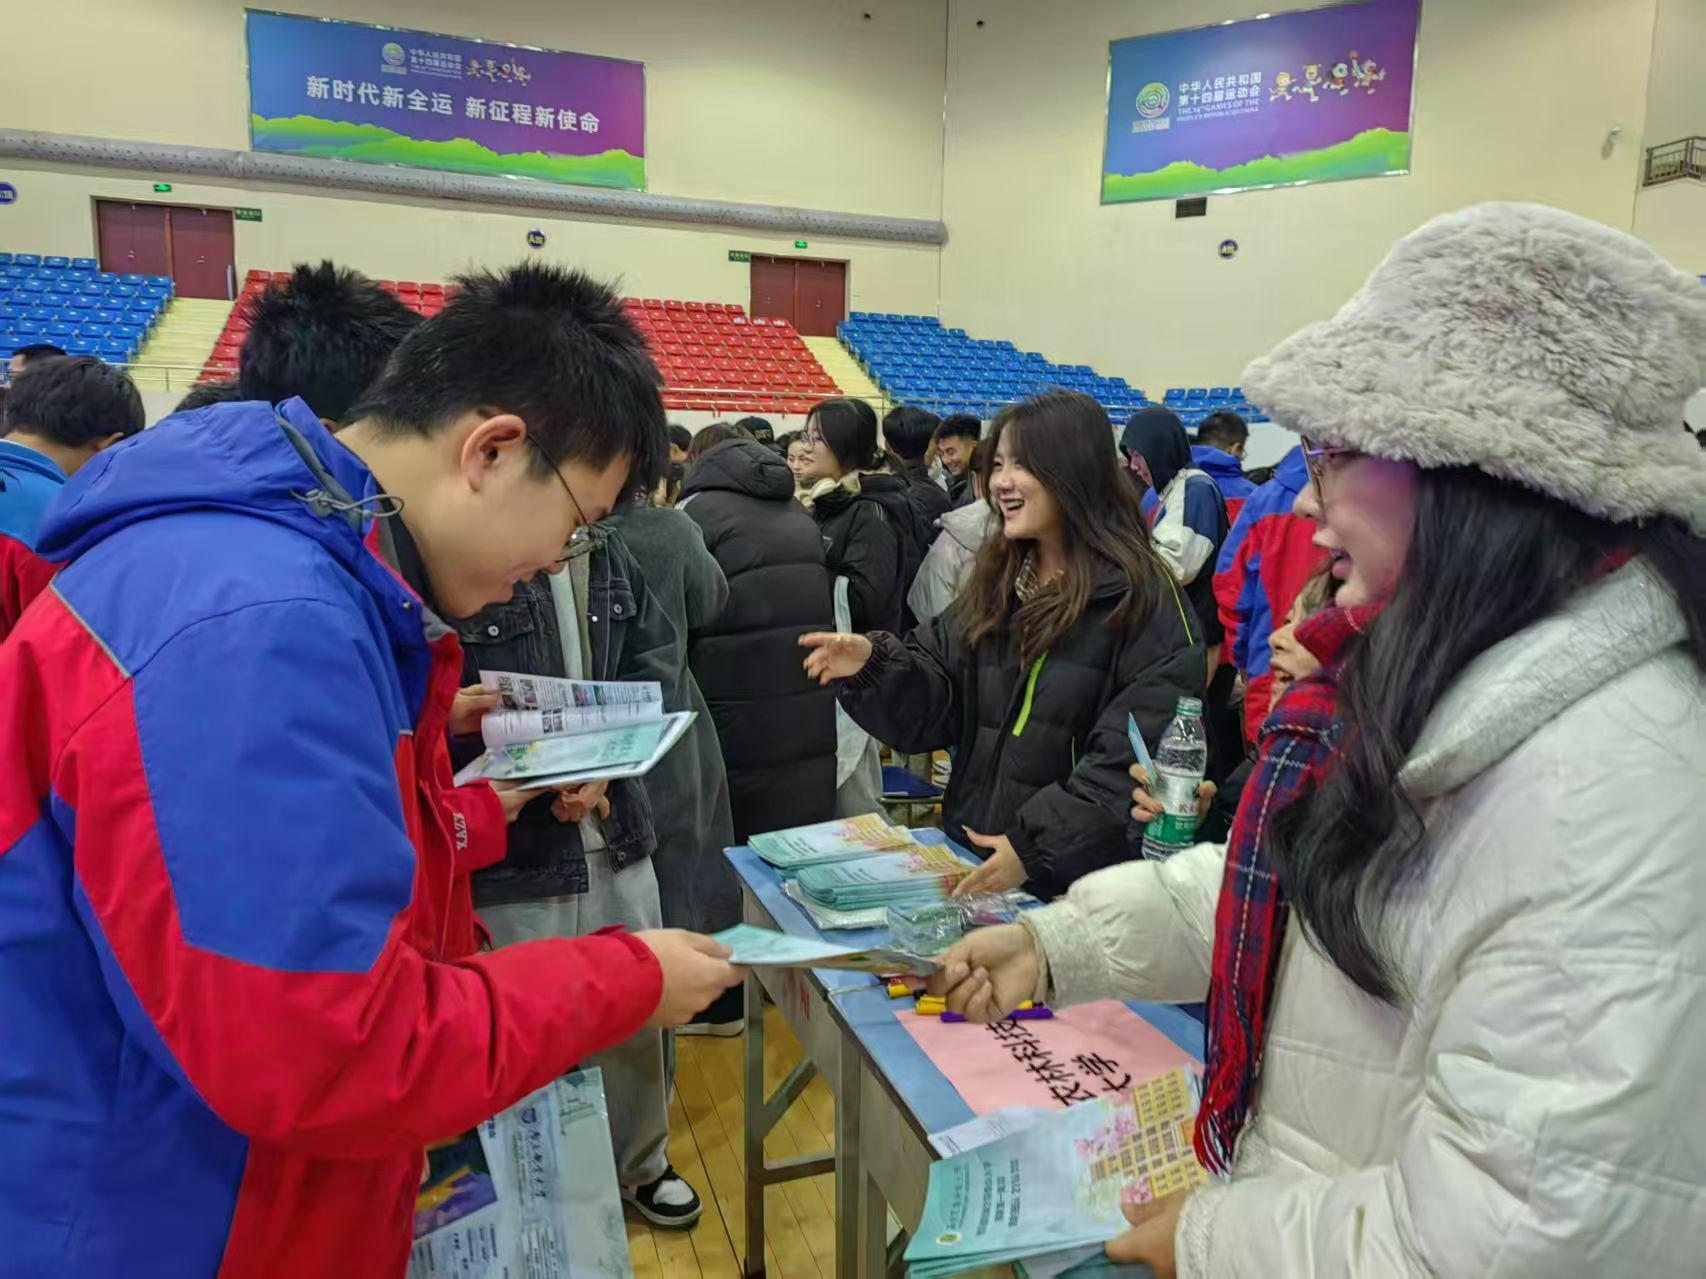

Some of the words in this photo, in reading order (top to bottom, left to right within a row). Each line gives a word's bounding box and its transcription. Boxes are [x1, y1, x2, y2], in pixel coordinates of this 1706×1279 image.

[1179, 72, 1262, 93] 中华人民共和国
[306, 75, 453, 115] 新时代新全运
[465, 96, 600, 133] 新征程新使命
[1178, 85, 1261, 107] 第十四届运动会
